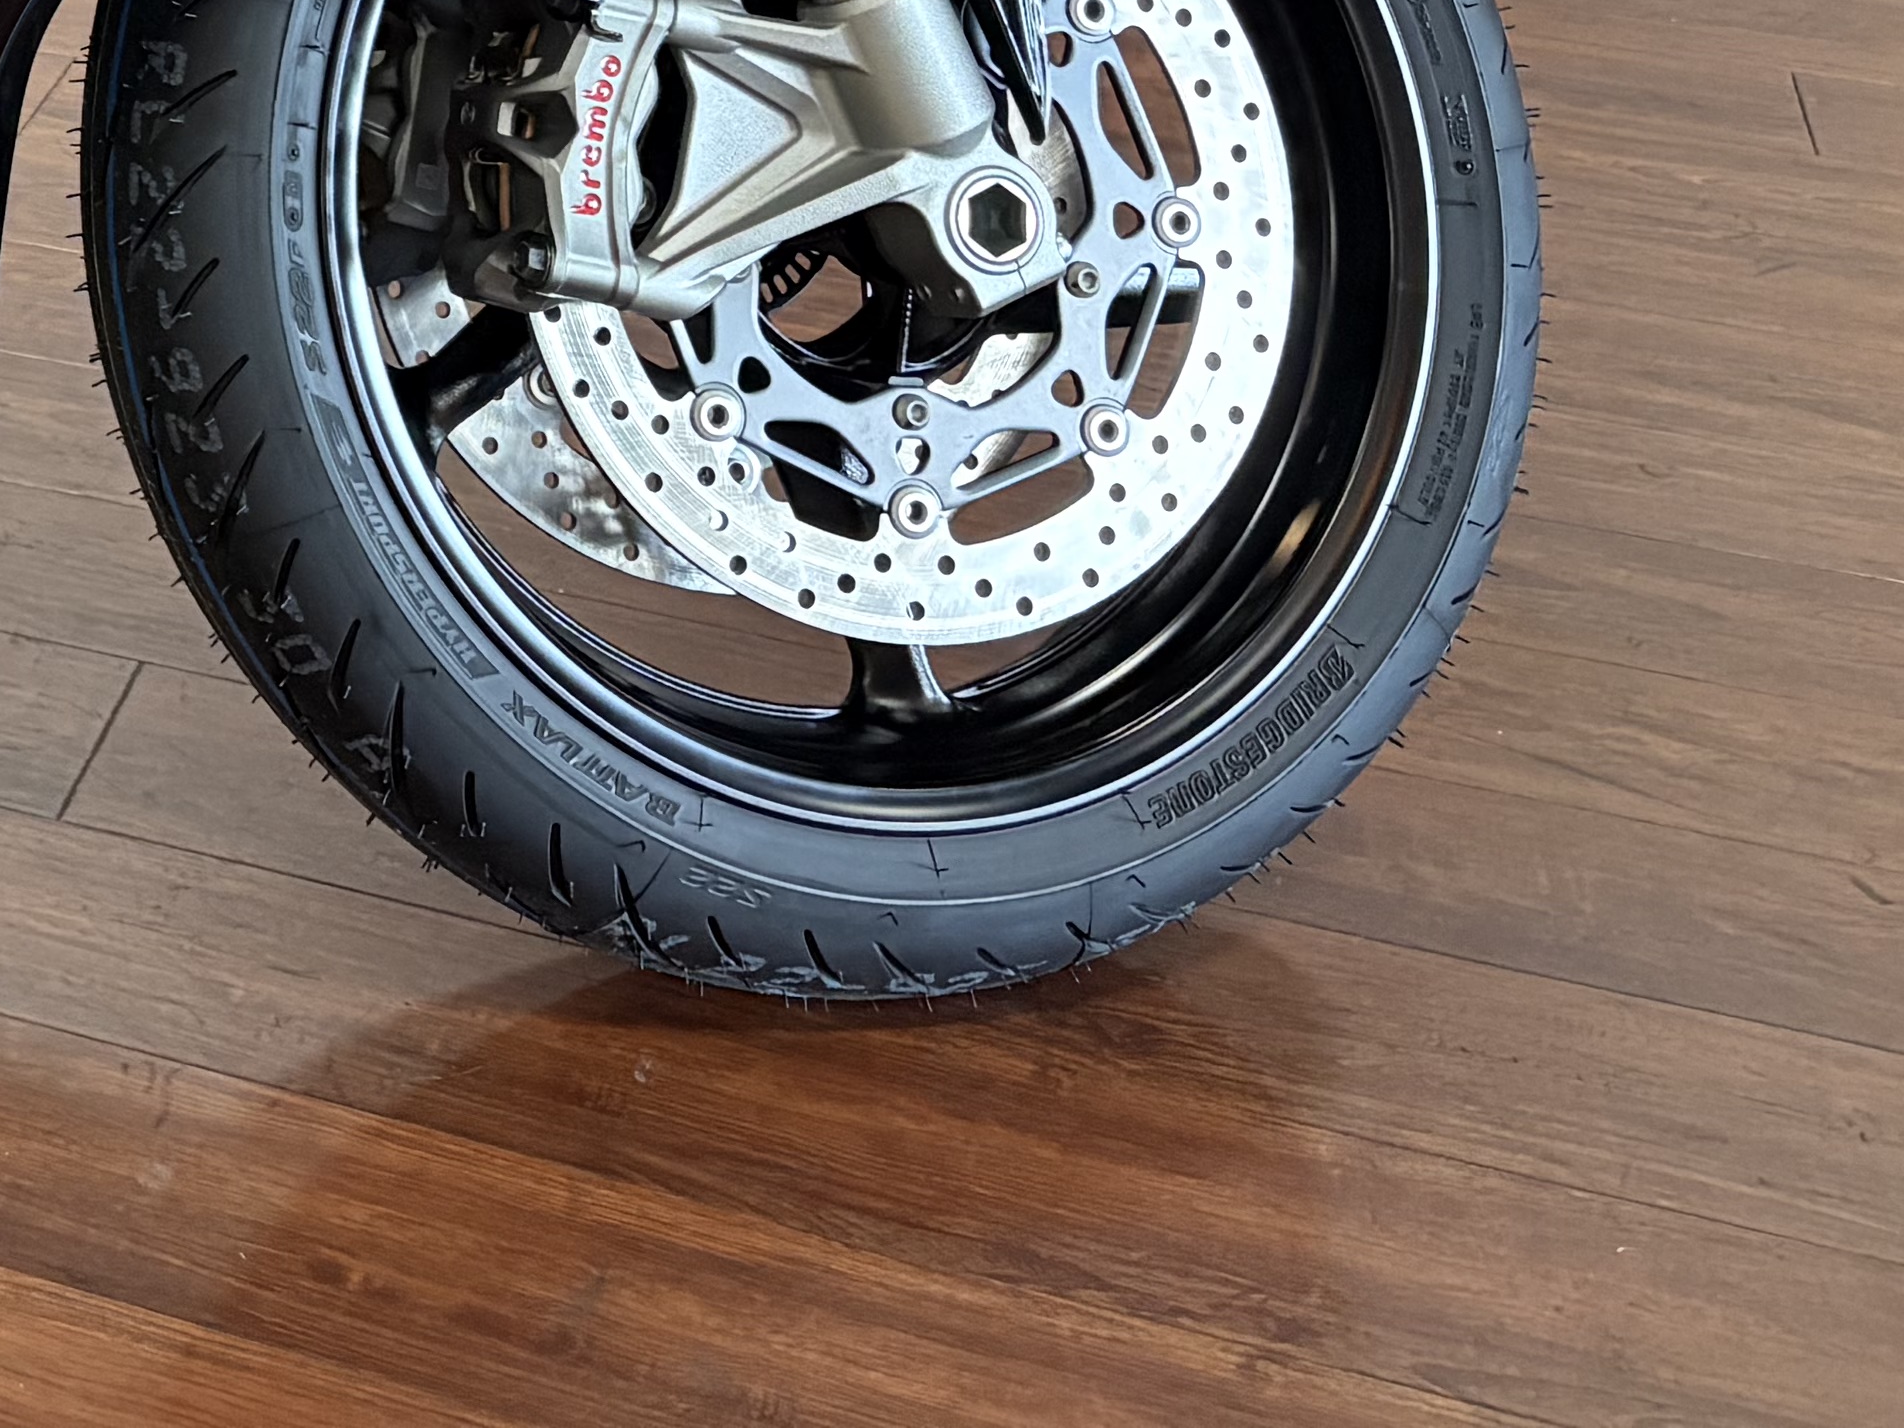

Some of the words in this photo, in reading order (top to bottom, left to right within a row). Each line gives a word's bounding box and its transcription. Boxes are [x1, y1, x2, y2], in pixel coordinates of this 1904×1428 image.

[571, 54, 623, 216] brembo
[352, 482, 475, 667] HYPERSPORT
[502, 689, 683, 827] BATTLAX
[1148, 646, 1356, 830] BRIDGESTONE
[679, 866, 772, 909] S22
